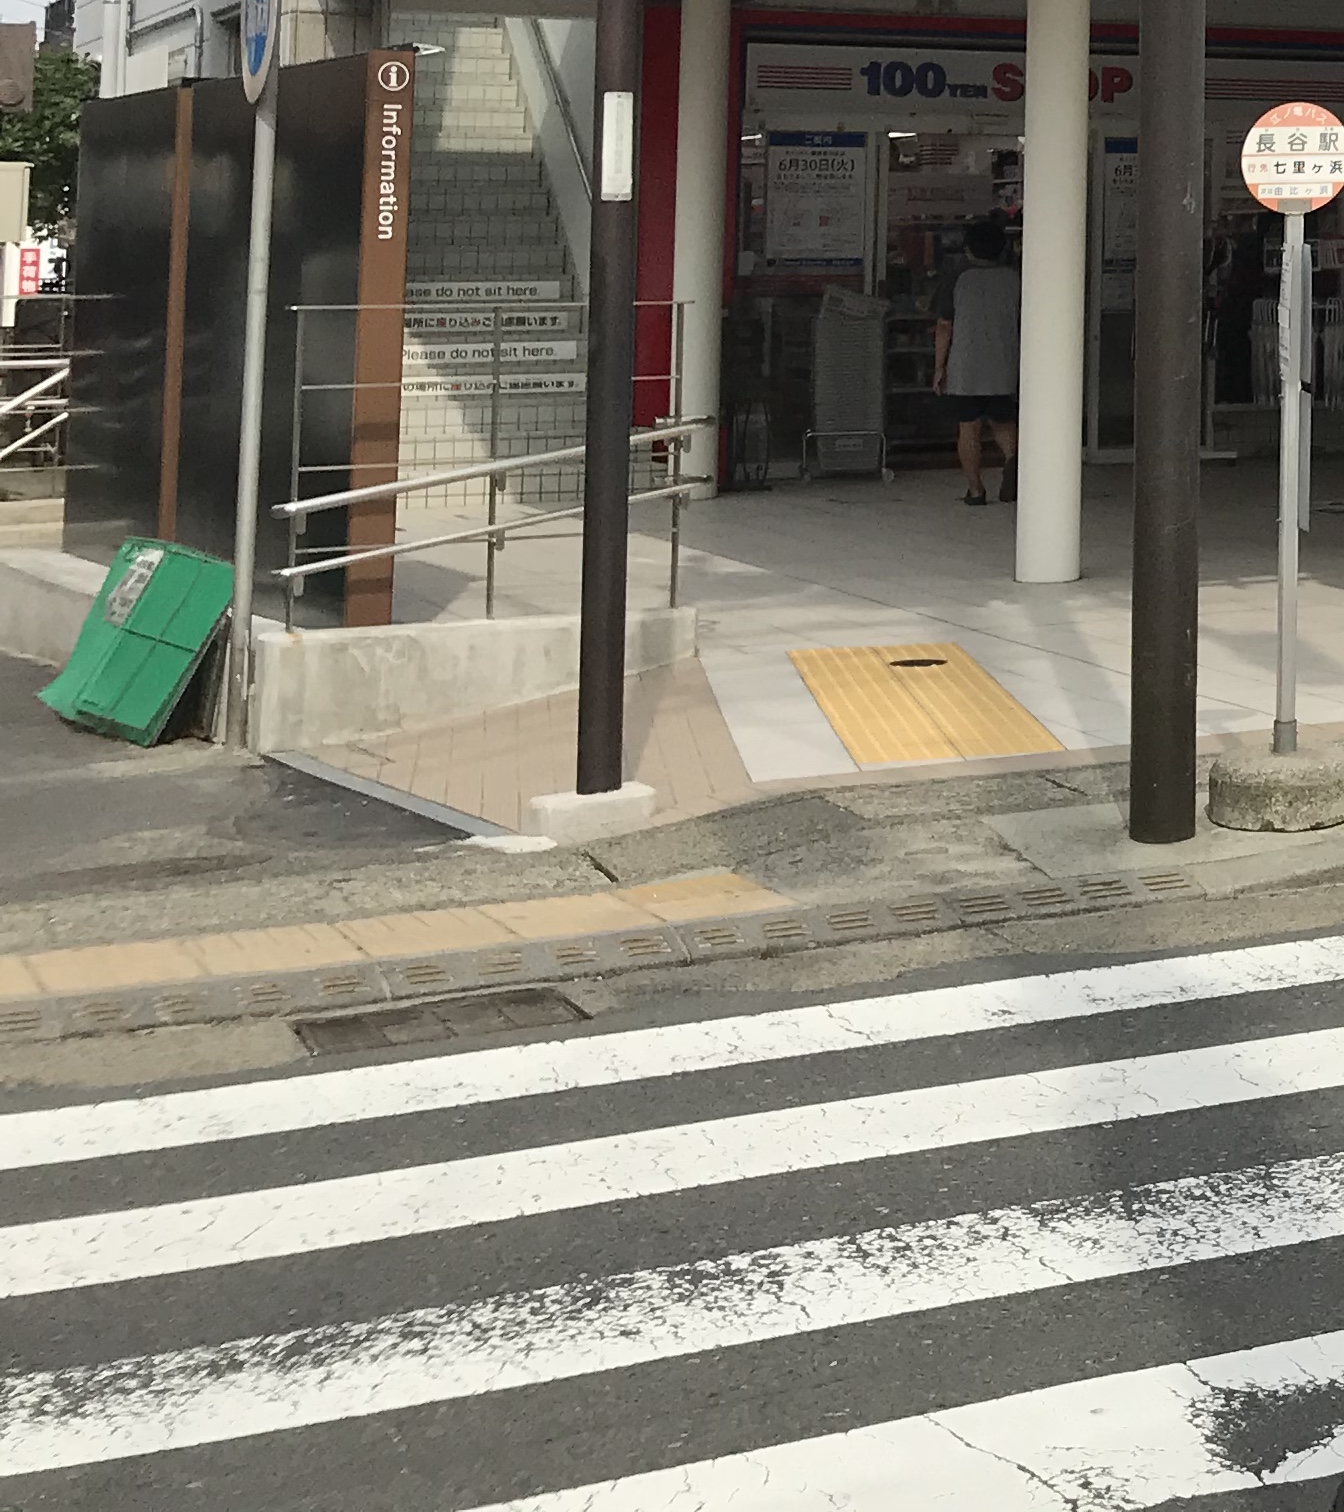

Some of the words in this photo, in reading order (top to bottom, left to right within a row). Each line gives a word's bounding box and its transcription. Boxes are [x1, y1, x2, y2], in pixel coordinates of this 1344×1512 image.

[860, 61, 946, 98] 100
[992, 62, 1133, 103] SP
[1256, 133, 1339, 153] 長谷駅
[377, 103, 402, 240] Information
[778, 158, 855, 172] 6月30日(火)
[435, 286, 453, 298] do
[457, 286, 481, 298] not
[450, 348, 468, 359] do
[472, 348, 494, 358] not
[500, 347, 518, 357] sit
